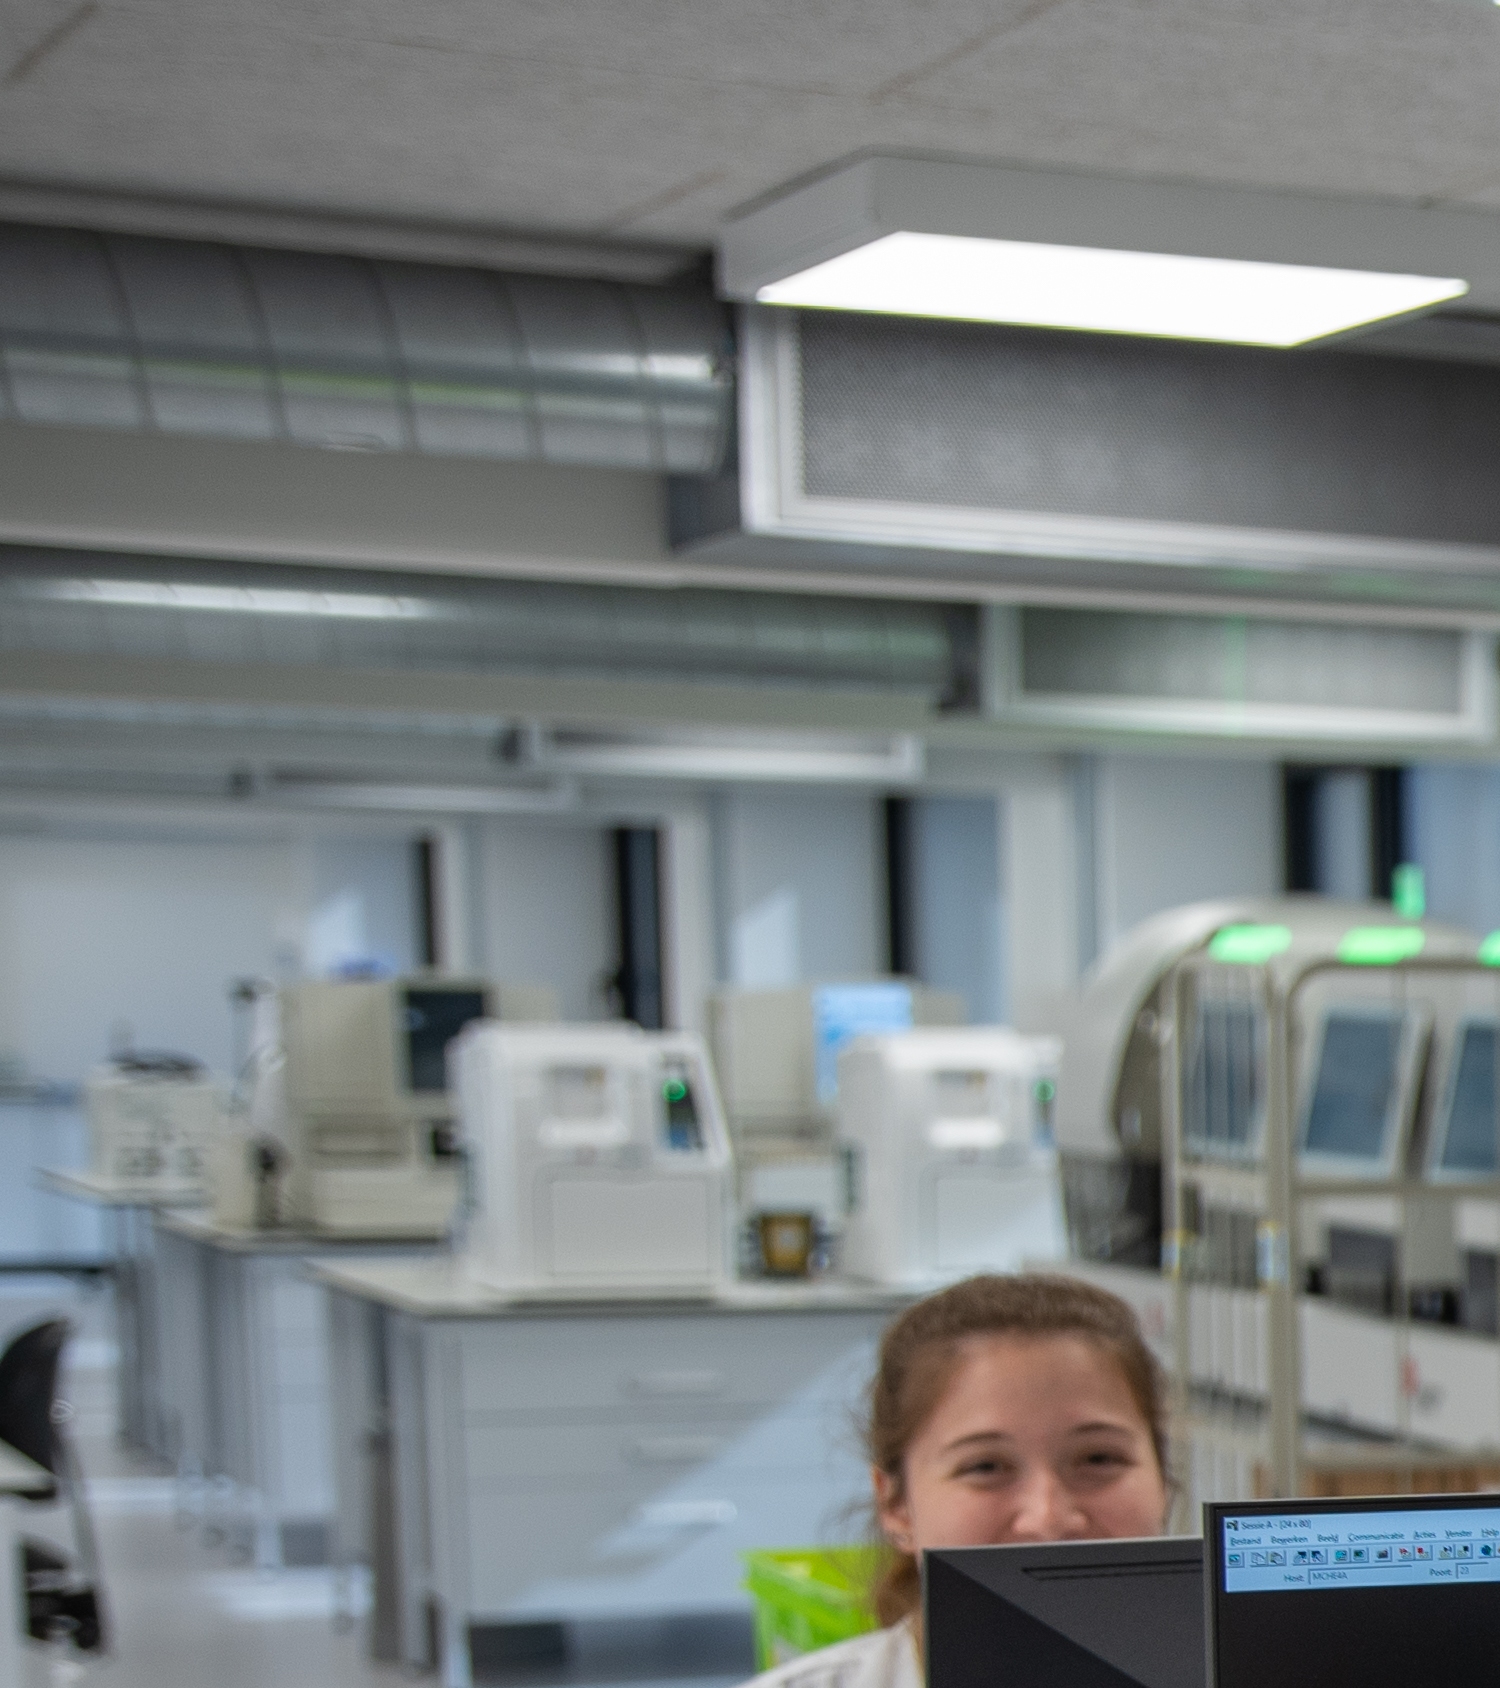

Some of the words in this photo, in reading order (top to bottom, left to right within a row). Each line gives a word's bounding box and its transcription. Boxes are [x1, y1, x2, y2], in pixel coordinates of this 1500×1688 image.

[1230, 1535, 1261, 1547] Bestand
[1271, 1534, 1309, 1545] Bewerken
[1317, 1533, 1339, 1543] Beeld
[1348, 1531, 1405, 1543] Communicatie
[1413, 1529, 1436, 1539] Acties
[1445, 1528, 1472, 1539] Venster
[1481, 1527, 1500, 1539] Help
